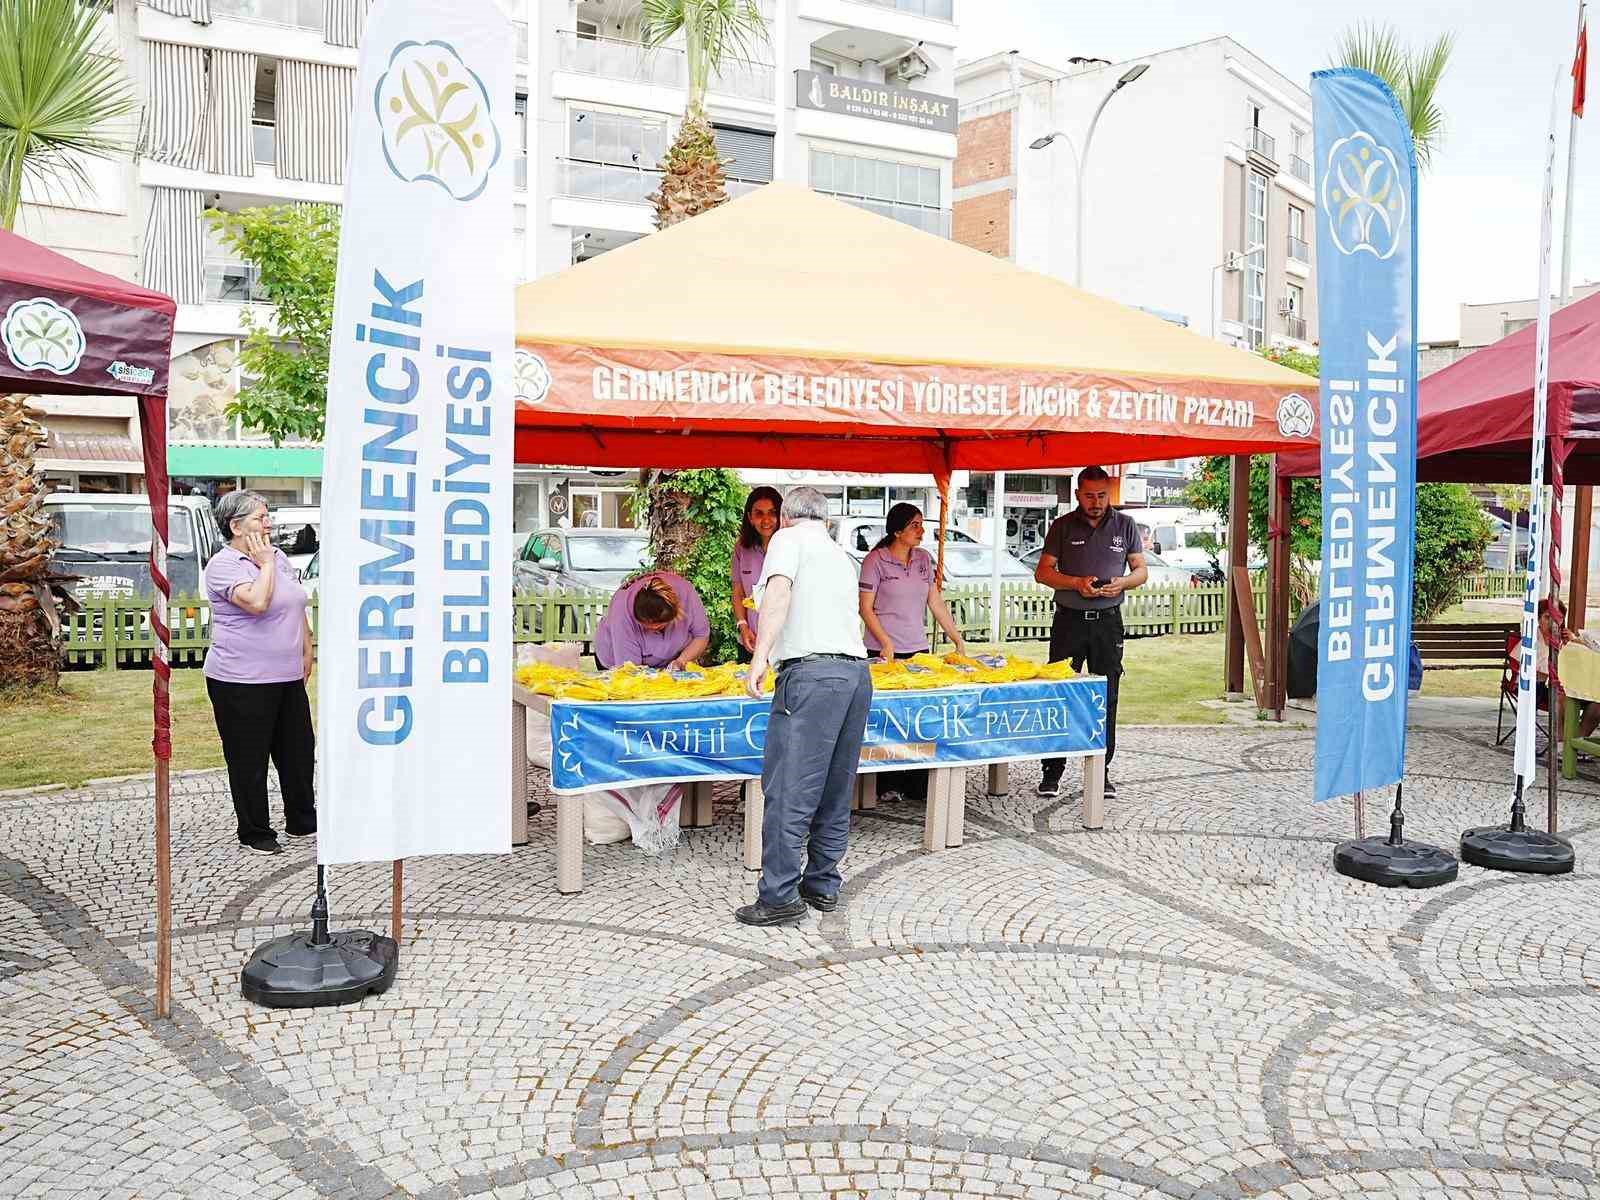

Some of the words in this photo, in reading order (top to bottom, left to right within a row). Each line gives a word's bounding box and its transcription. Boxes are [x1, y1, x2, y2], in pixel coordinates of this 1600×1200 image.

[829, 83, 888, 106] BALDIR
[893, 91, 949, 118] İNŞAAT
[592, 367, 757, 405] GERMENCİK
[764, 370, 904, 413] BELEDİYESİ
[911, 376, 1008, 416] YÖRESEL
[1018, 381, 1080, 418] İNCİR
[1087, 393, 1102, 419] &
[1107, 388, 1177, 423] ZEYTİN
[1183, 399, 1254, 428] PAZARI
[356, 268, 424, 746] GERMENCİK
[433, 344, 491, 684] BELEDİYESİ
[613, 720, 726, 758] TARİHİ
[983, 708, 1069, 736] PAZARI
